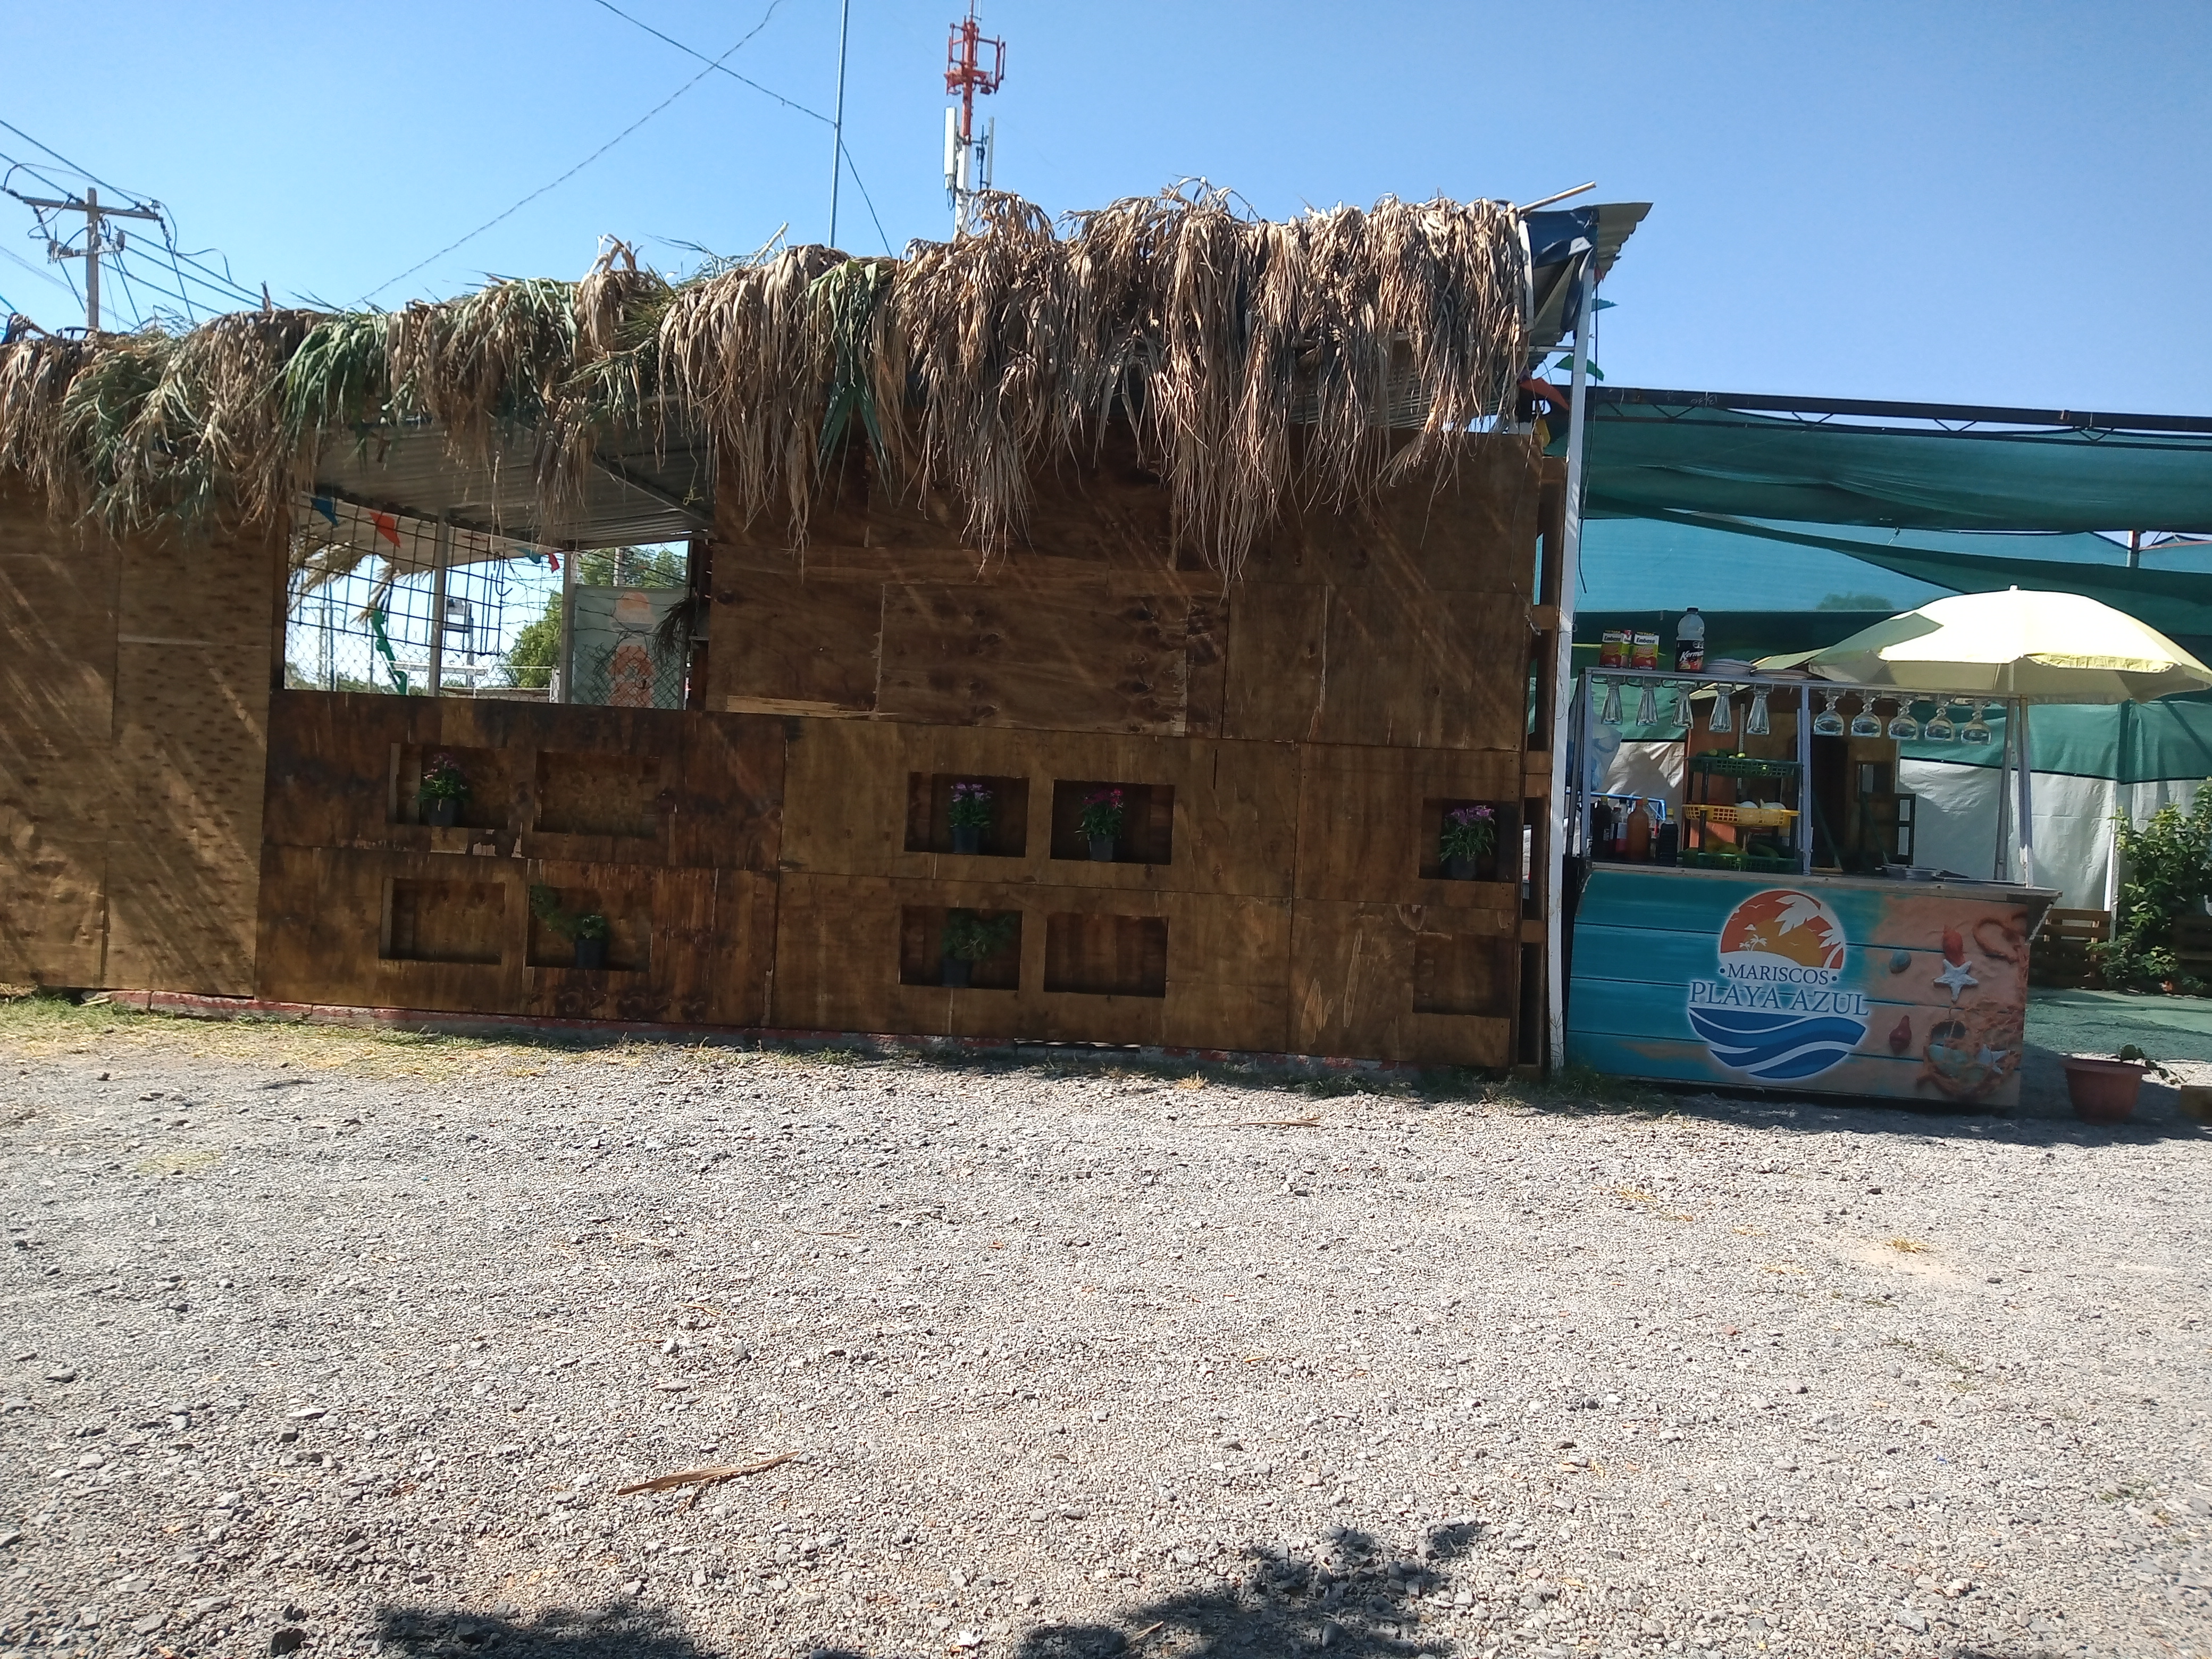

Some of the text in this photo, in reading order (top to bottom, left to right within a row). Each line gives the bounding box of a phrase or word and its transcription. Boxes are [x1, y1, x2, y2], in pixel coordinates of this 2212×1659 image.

[1727, 963, 1829, 985] MARISCOS
[1689, 981, 1870, 1016] PLAYA AZUL
